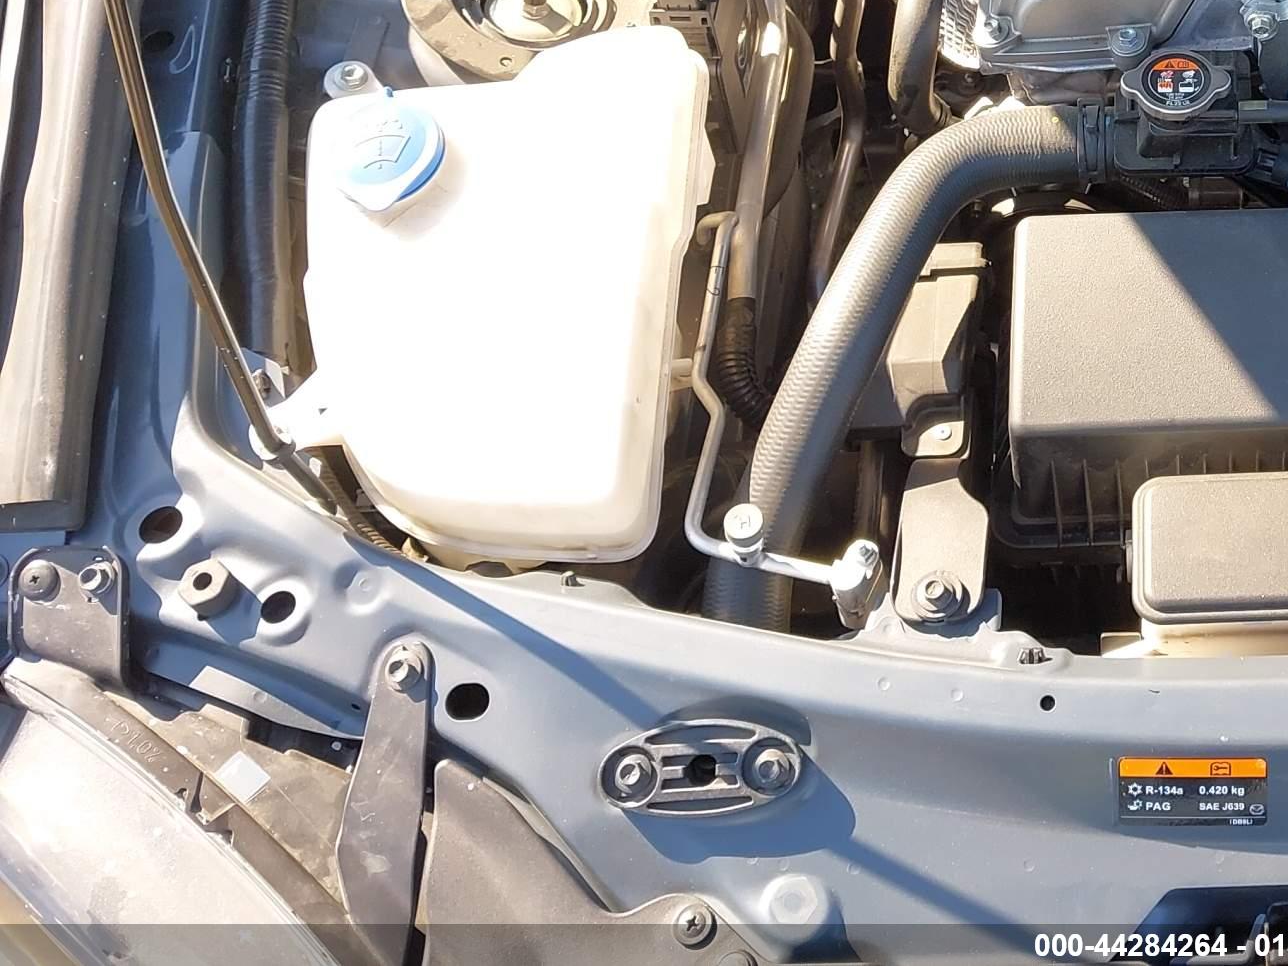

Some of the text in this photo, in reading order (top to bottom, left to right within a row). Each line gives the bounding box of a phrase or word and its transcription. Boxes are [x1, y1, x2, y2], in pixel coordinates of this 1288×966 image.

[1145, 785, 1184, 795] R-134a
[1199, 785, 1245, 796] 0.420 kg
[1145, 802, 1171, 811] PAG
[1199, 802, 1245, 811] SAE J639
